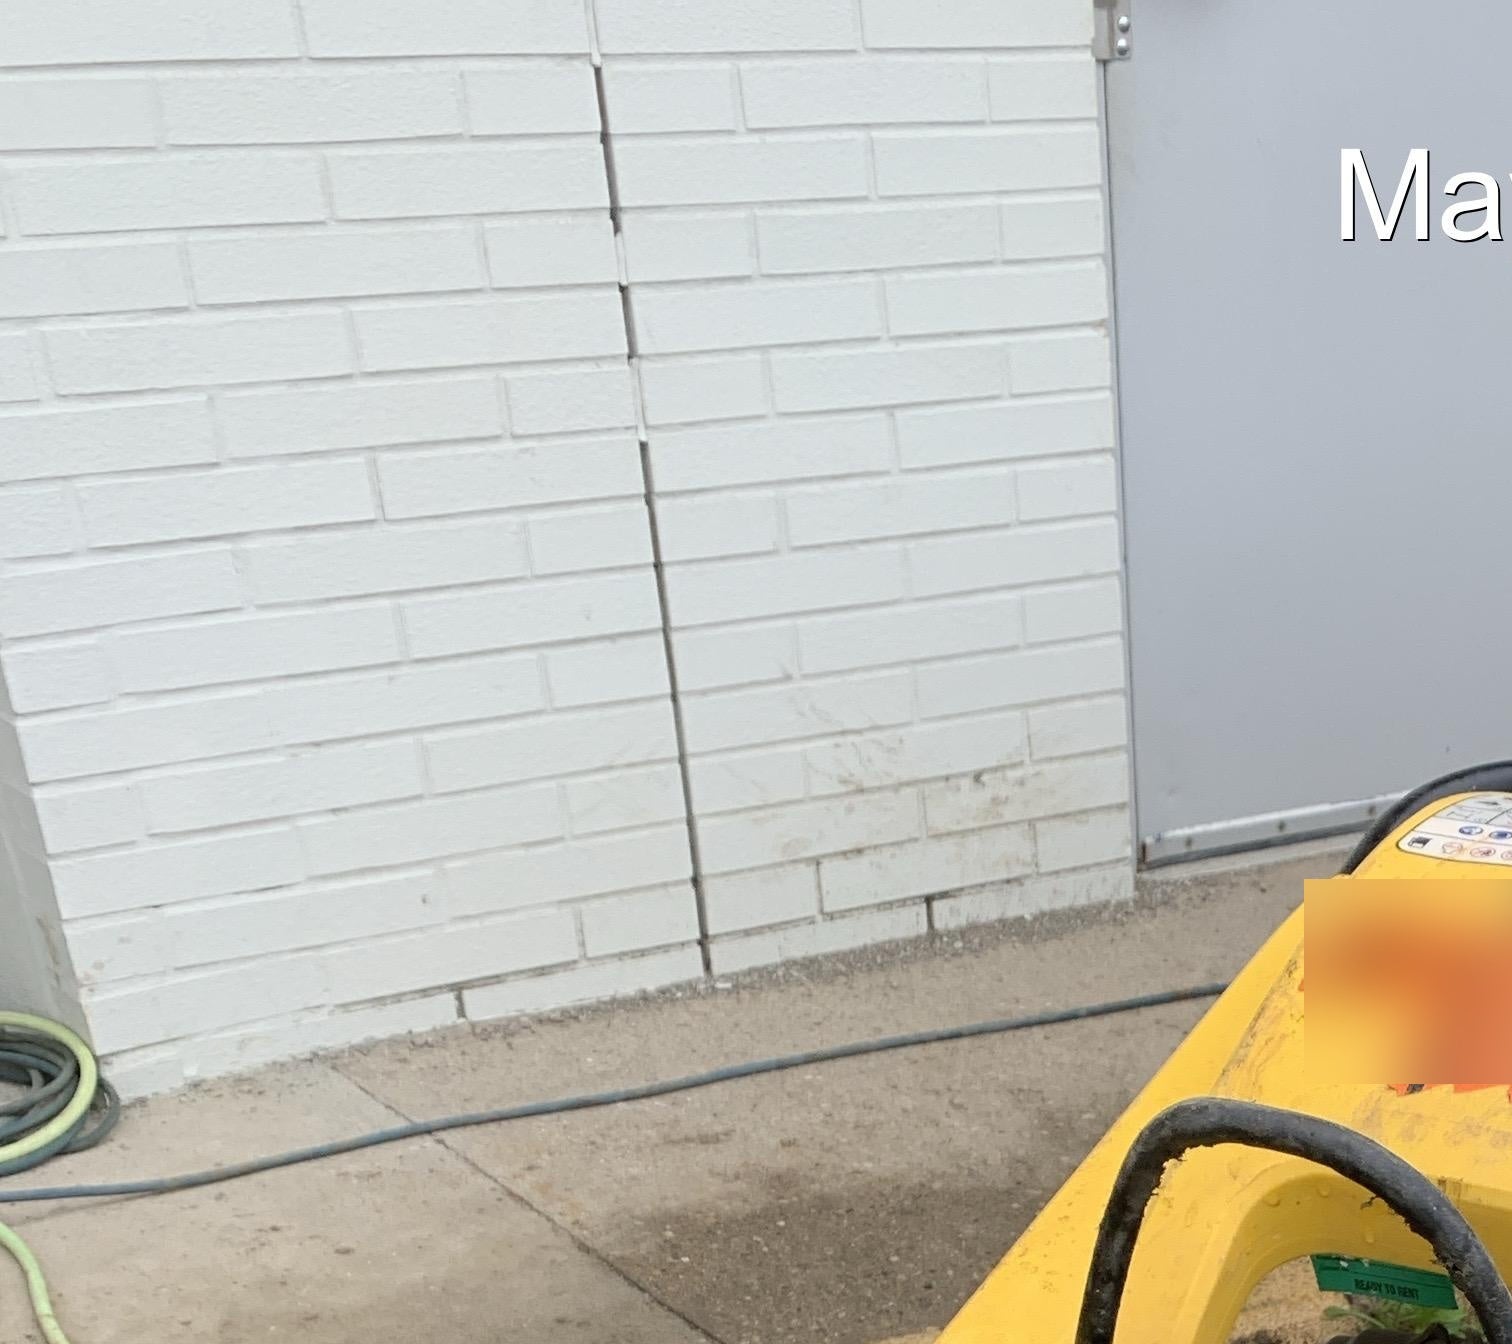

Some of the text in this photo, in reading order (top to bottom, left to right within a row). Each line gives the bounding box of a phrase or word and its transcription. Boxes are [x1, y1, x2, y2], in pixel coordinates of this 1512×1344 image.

[1354, 1278, 1419, 1300] READY TO RENT
